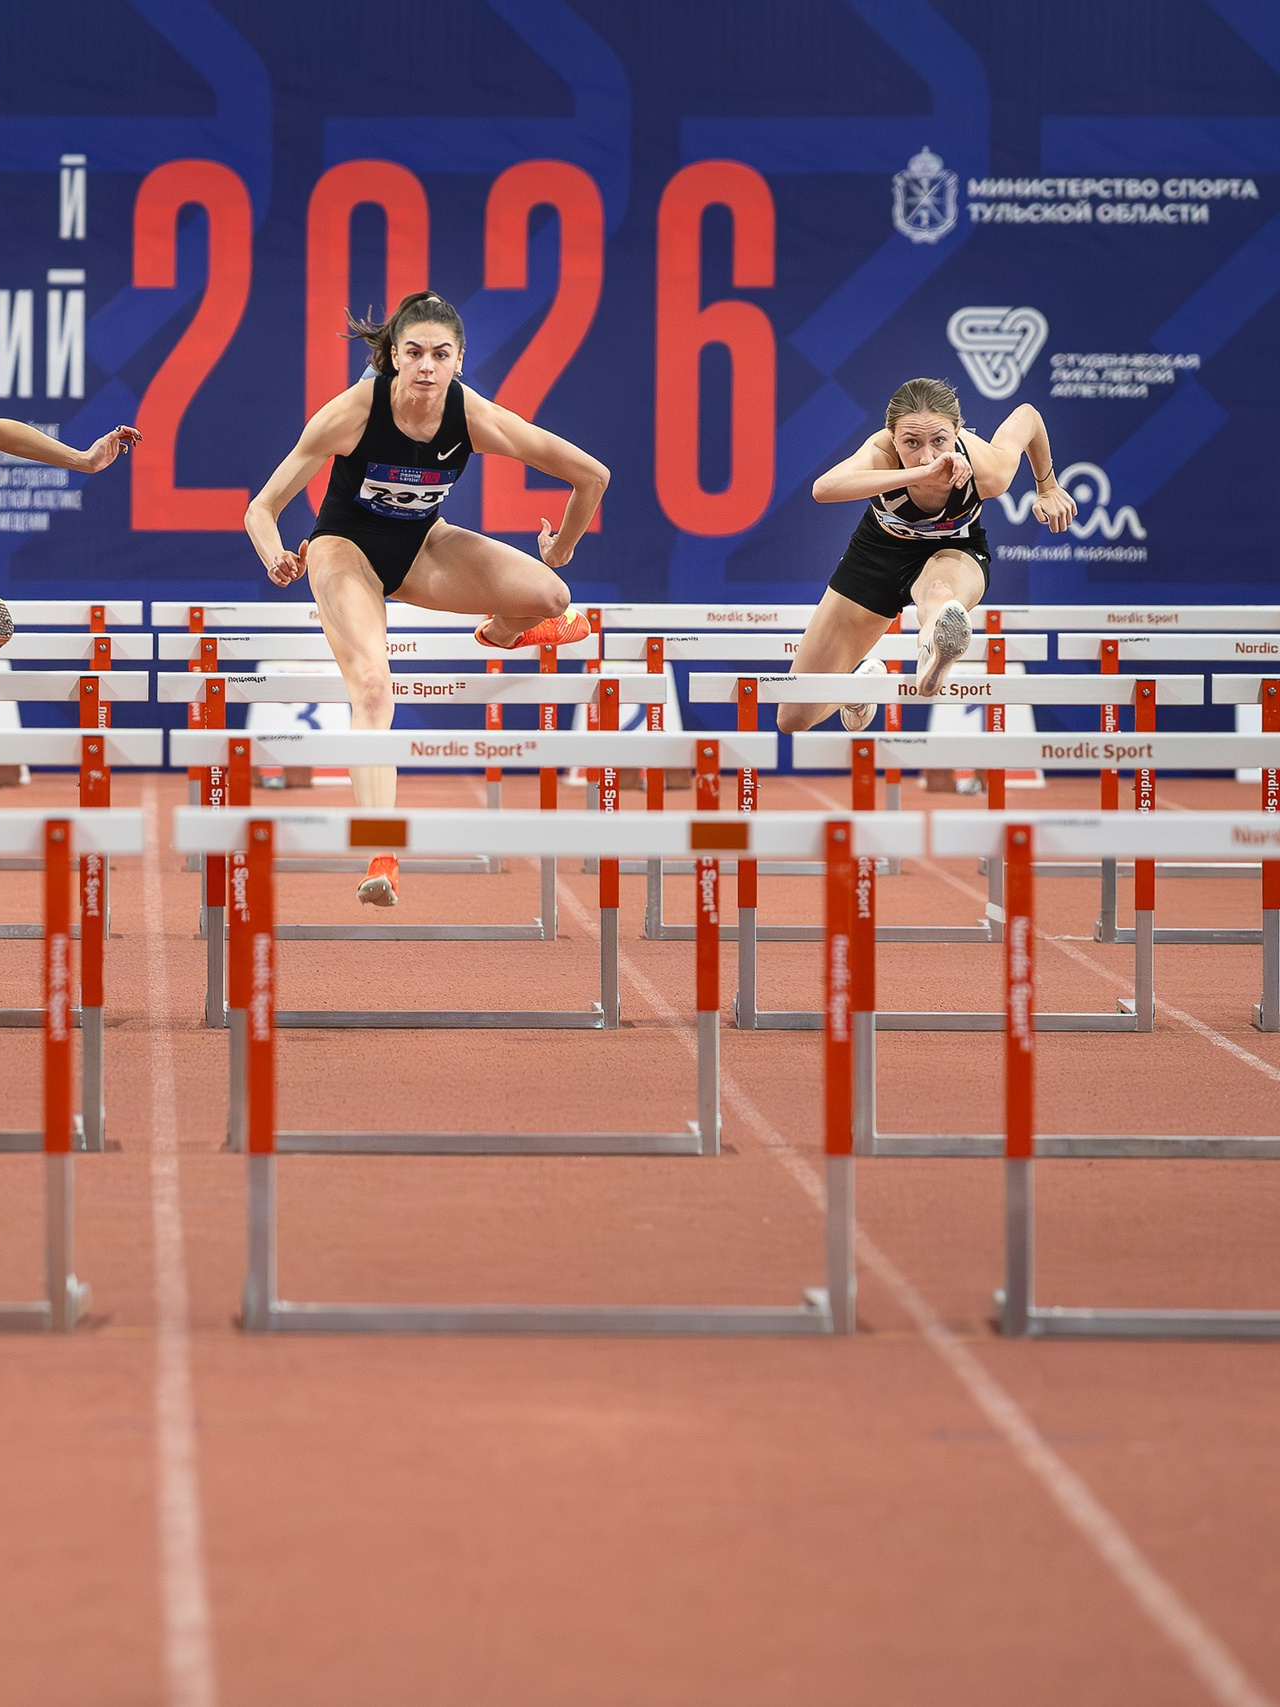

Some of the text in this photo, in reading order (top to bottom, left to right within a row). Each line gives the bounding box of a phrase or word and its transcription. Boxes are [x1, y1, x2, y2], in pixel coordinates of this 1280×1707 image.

[967, 178, 1260, 199] МИНИСТЕРСТВО СПОРТА
[968, 200, 1210, 224] ТУЛЬСКОЙ ОБЛАСТИ
[129, 158, 776, 537] 2026
[1235, 642, 1279, 655] Nordic
[413, 683, 454, 699] Sport
[949, 683, 992, 700] Sport
[1105, 705, 1116, 732] ordic
[411, 741, 524, 759] Nordic Sport
[1104, 743, 1153, 762] Sport
[743, 767, 755, 794] ordic
[1140, 769, 1153, 797] ordic
[1267, 768, 1279, 797] ordic
